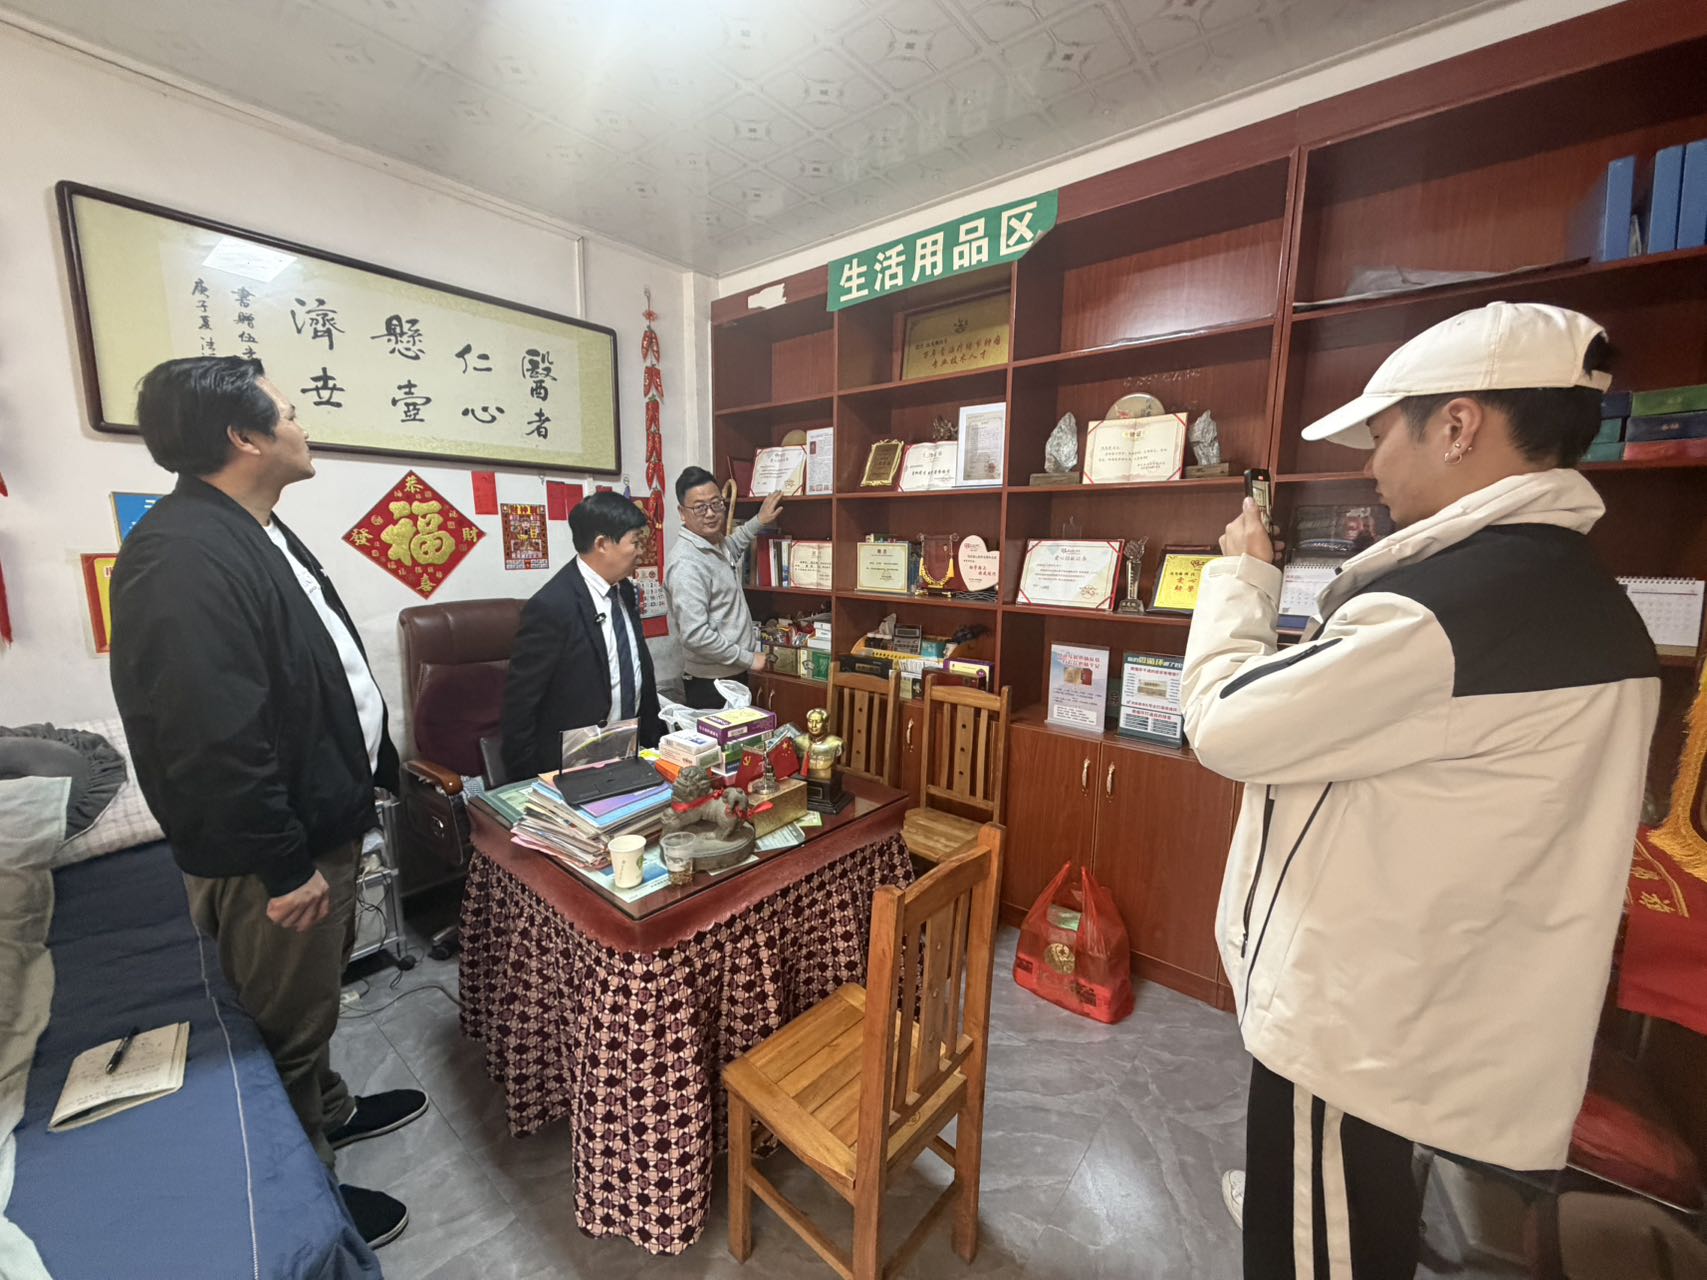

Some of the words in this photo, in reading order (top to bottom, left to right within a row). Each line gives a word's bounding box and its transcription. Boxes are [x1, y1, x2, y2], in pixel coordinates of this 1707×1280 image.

[840, 201, 1038, 303] 生活用品区
[455, 344, 505, 424] 仁心
[521, 349, 558, 440] 醫者
[404, 475, 424, 494] 恭
[380, 500, 456, 567] 福
[462, 527, 480, 543] 財
[416, 573, 437, 593] 喜
